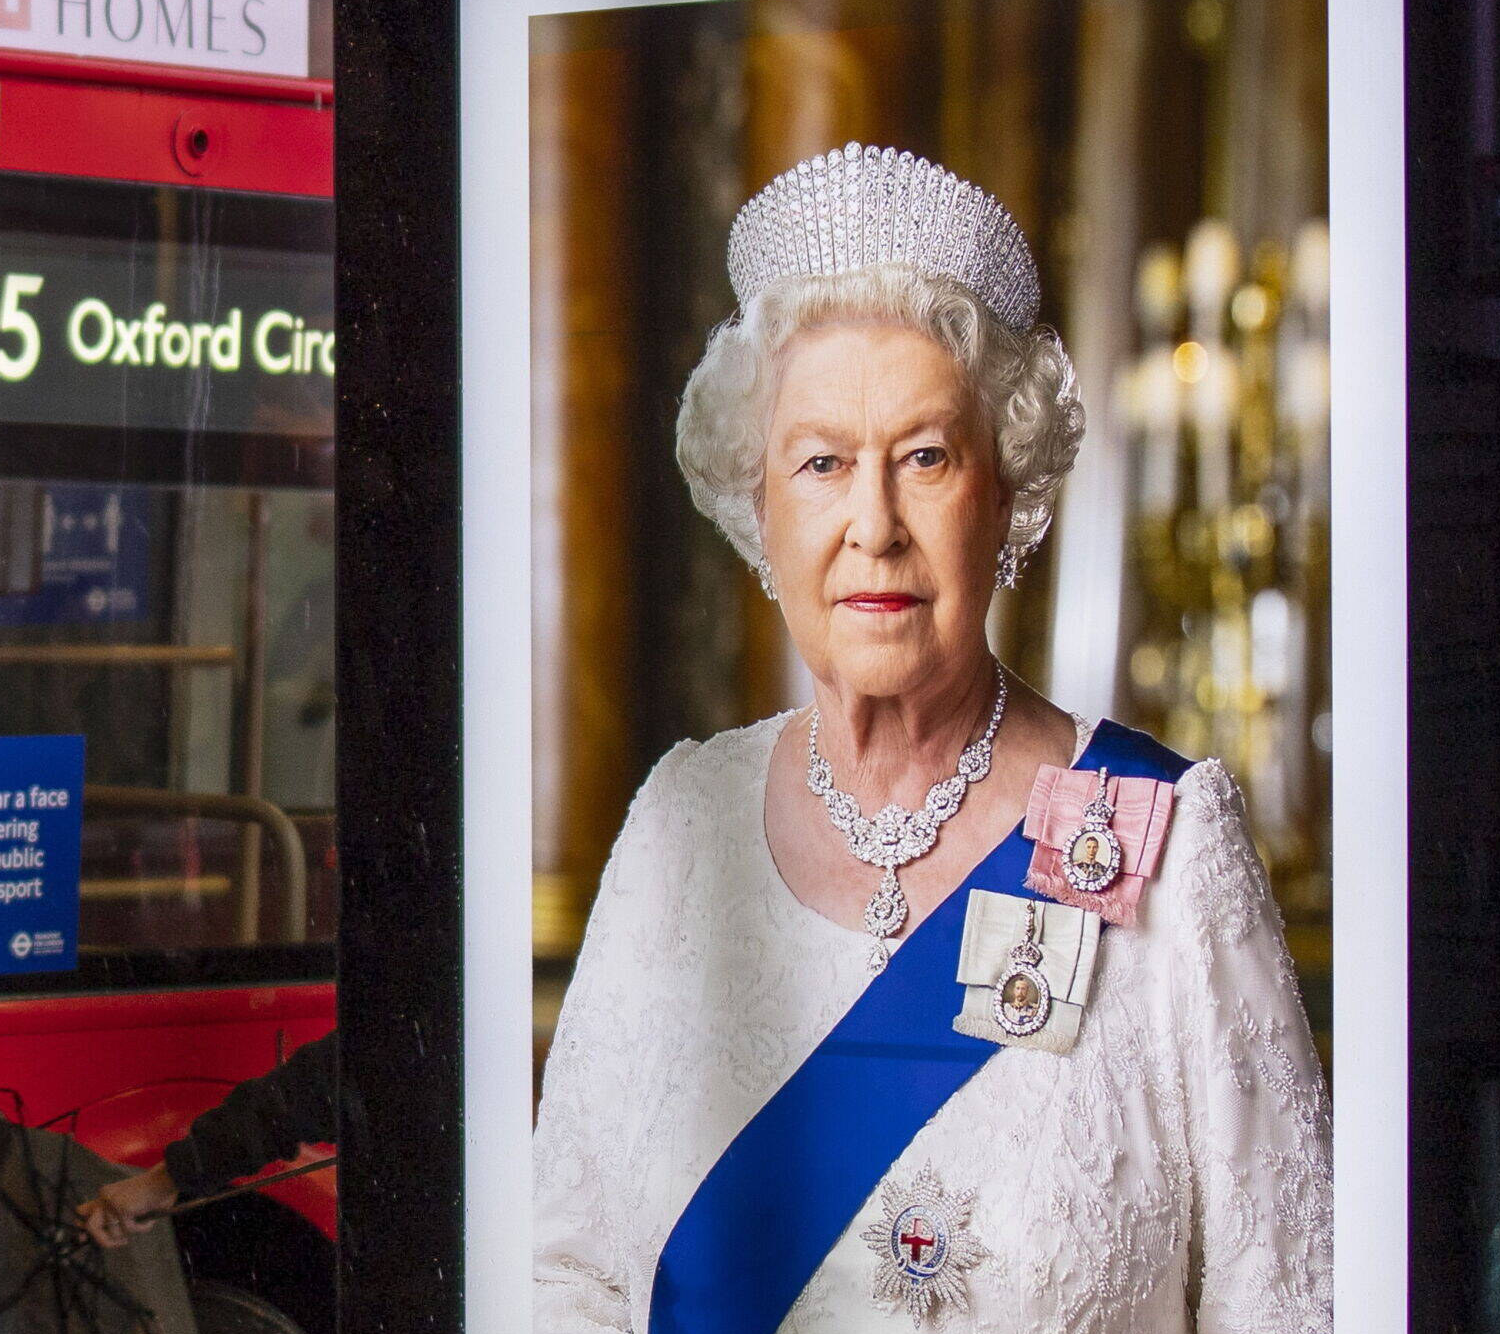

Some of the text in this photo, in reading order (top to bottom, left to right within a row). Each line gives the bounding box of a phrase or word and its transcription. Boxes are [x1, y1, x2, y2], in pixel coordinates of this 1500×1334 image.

[67, 297, 242, 372] Oxford
[14, 791, 26, 809] a
[29, 783, 69, 808] face
